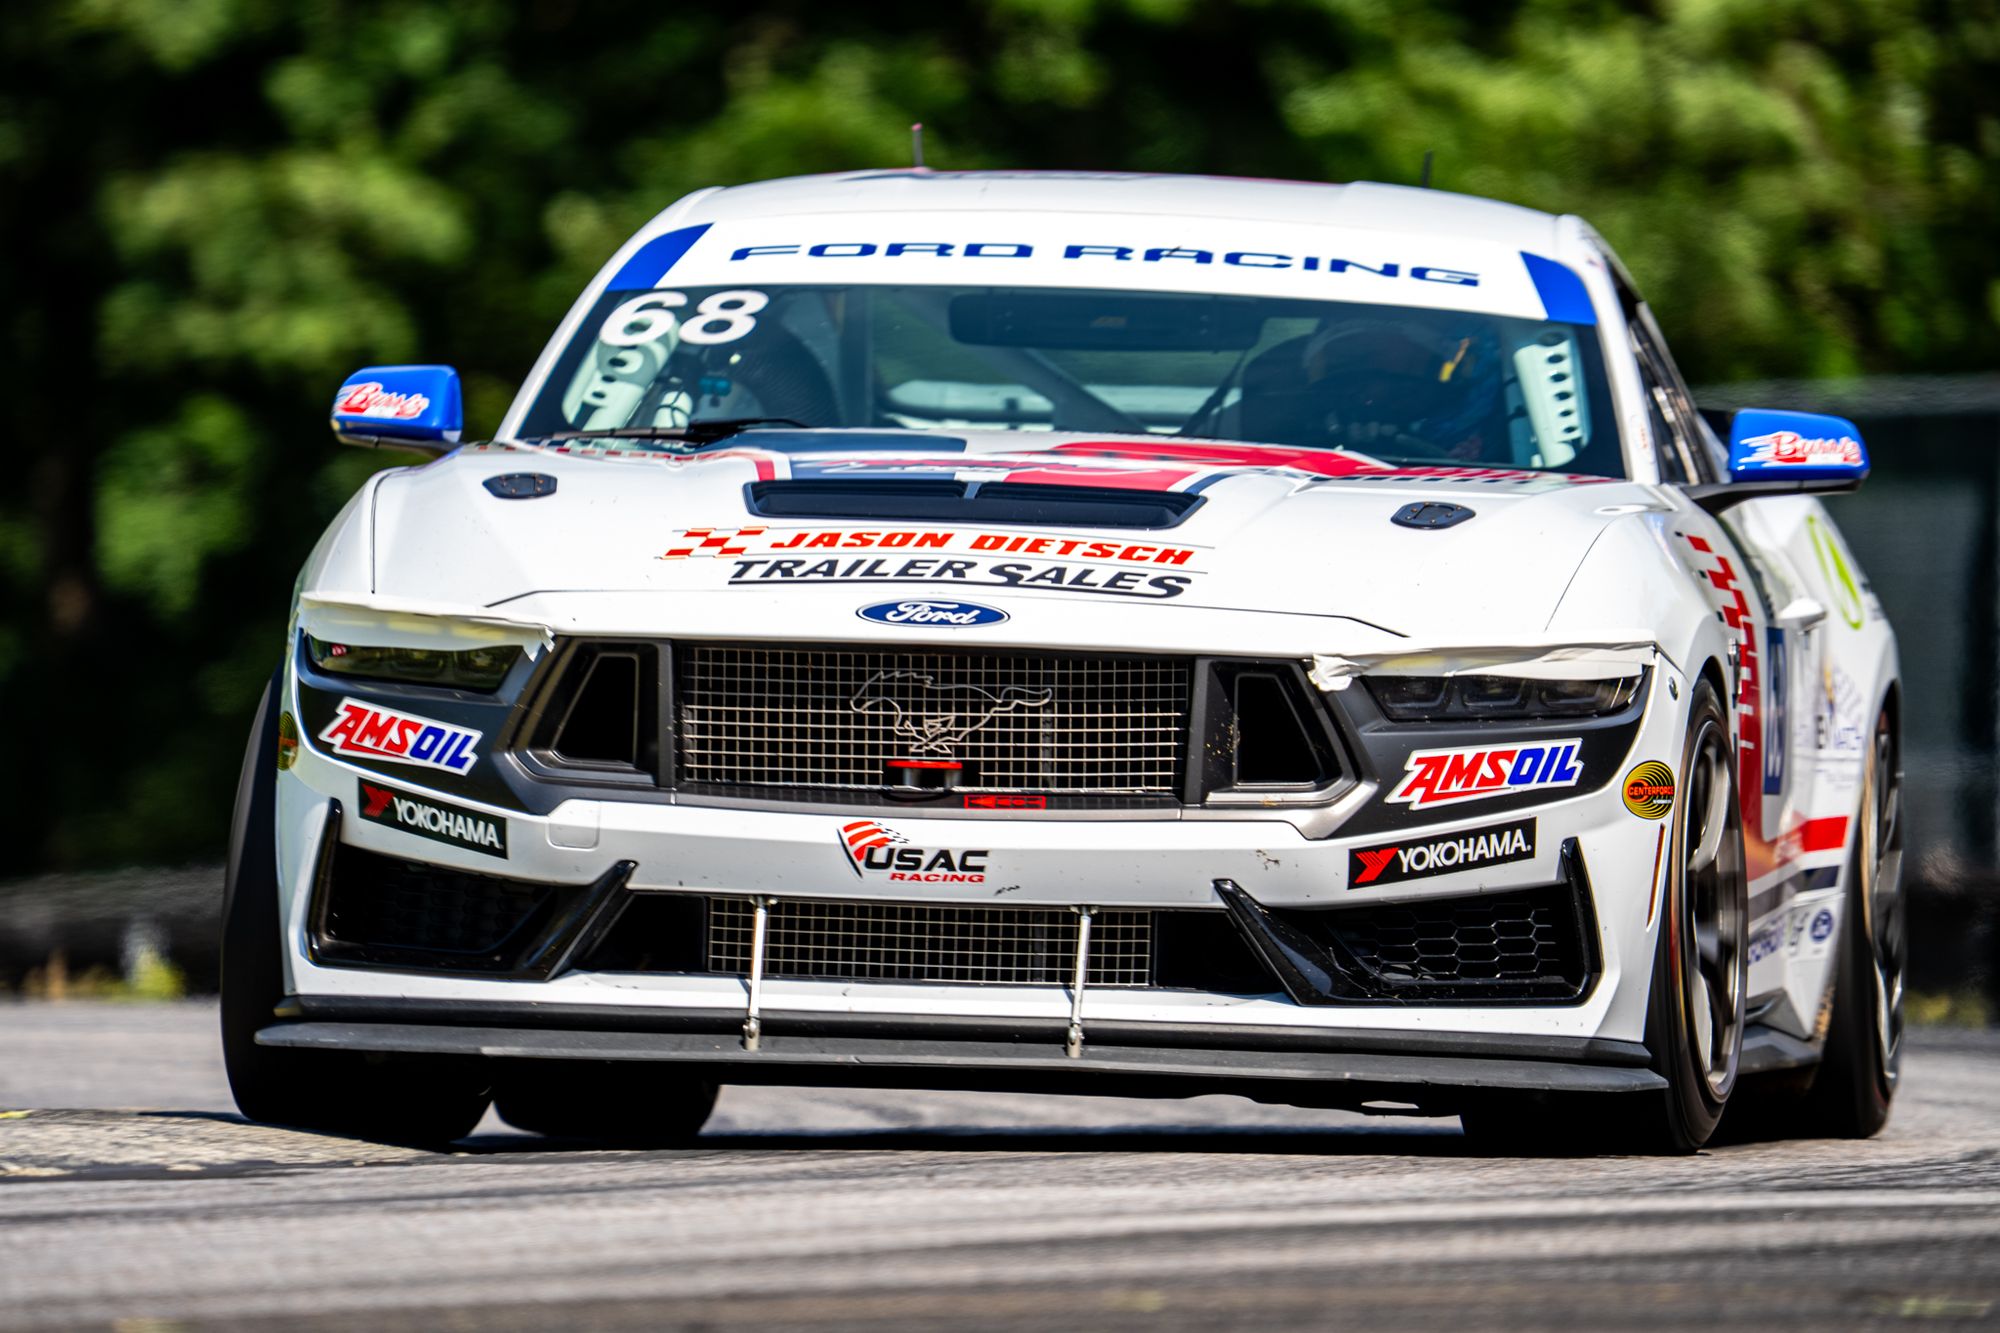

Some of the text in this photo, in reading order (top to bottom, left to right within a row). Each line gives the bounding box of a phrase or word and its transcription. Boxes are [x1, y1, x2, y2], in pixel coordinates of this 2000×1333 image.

[730, 243, 1480, 287] FORD RACING
[600, 289, 769, 347] 68
[769, 532, 1195, 566] JASON DIETSCH
[731, 558, 1193, 599] TRAILER SALES
[885, 601, 982, 625] Ford
[327, 704, 475, 769] AMSOIL
[1399, 744, 1578, 804] AMSOIL
[1627, 785, 1675, 797] CENTERFORCE
[392, 796, 504, 850] YOKOHAMA
[864, 846, 989, 873] USAC
[1397, 828, 1528, 873] YOKOHAMA
[888, 872, 985, 883] RACING
